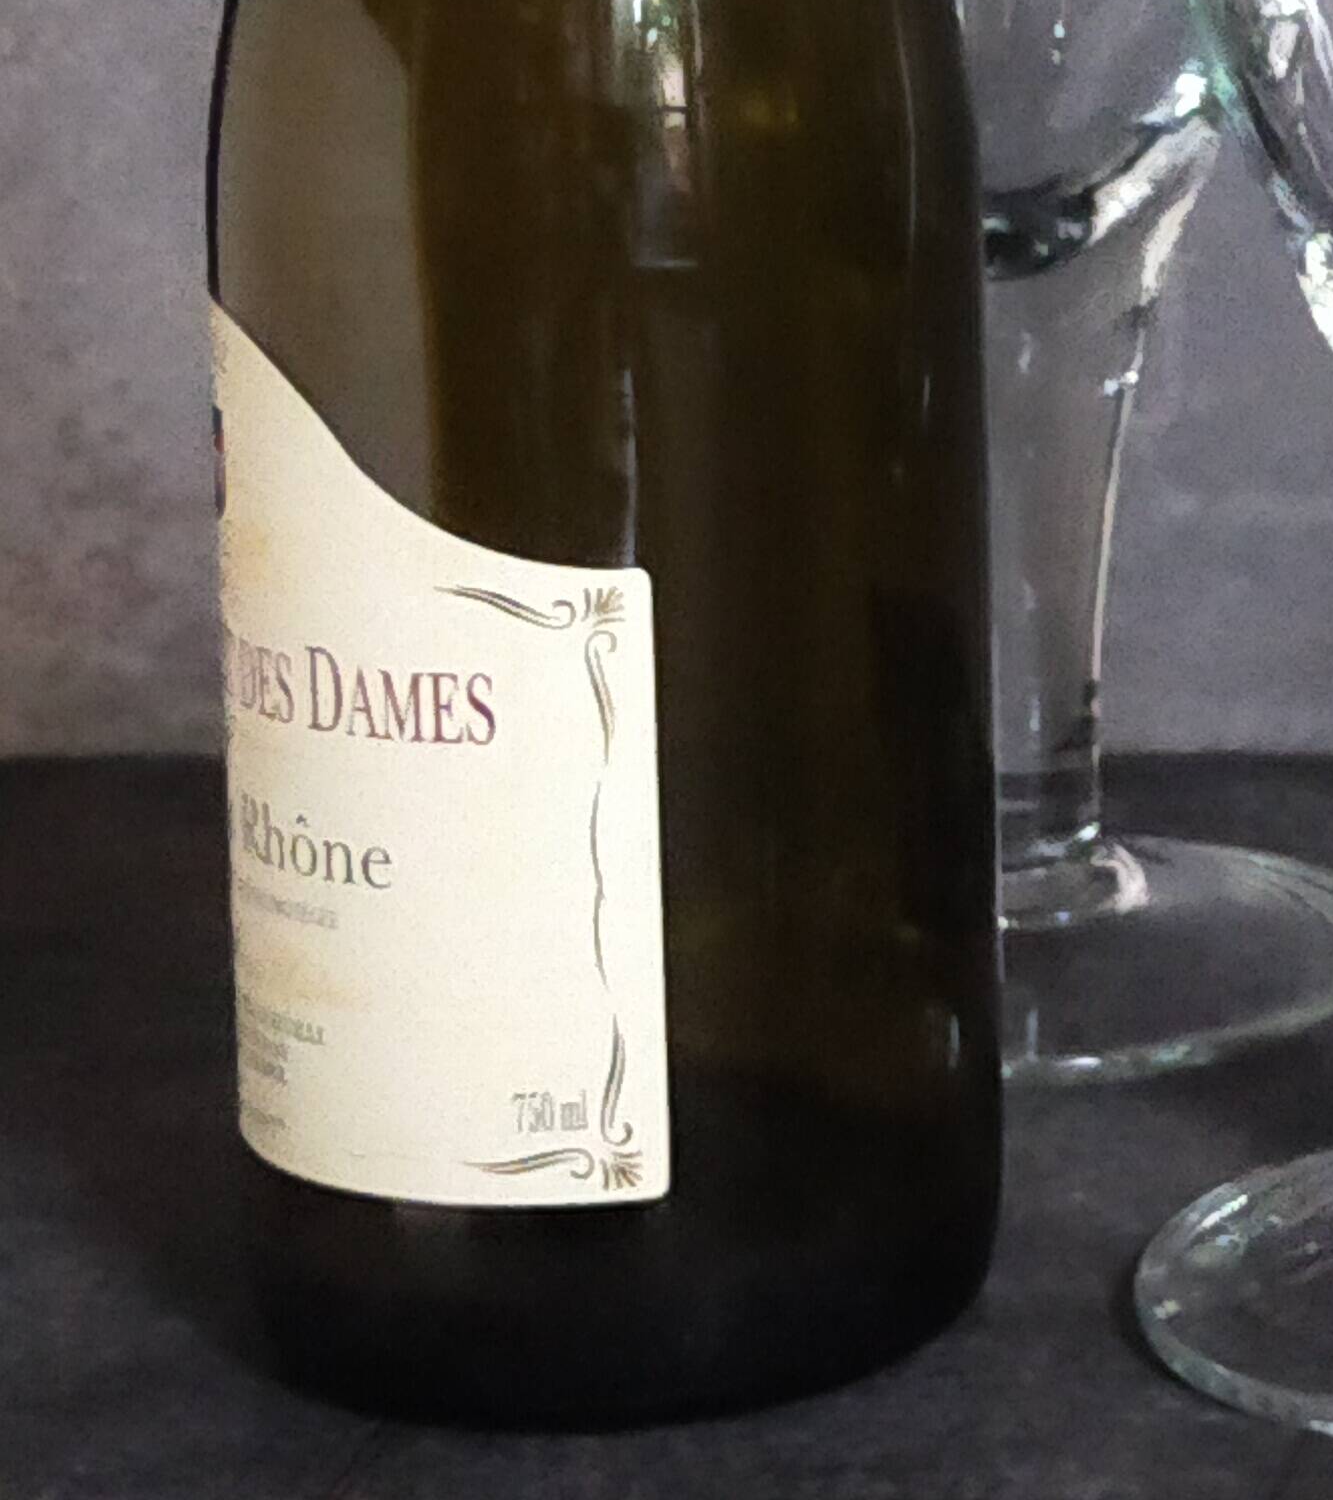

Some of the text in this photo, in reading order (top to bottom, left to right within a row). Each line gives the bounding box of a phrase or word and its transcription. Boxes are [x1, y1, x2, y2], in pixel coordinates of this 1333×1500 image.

[238, 638, 497, 746] DES DAMES
[240, 792, 393, 890] Rhône
[511, 1088, 589, 1134] 750 ml
